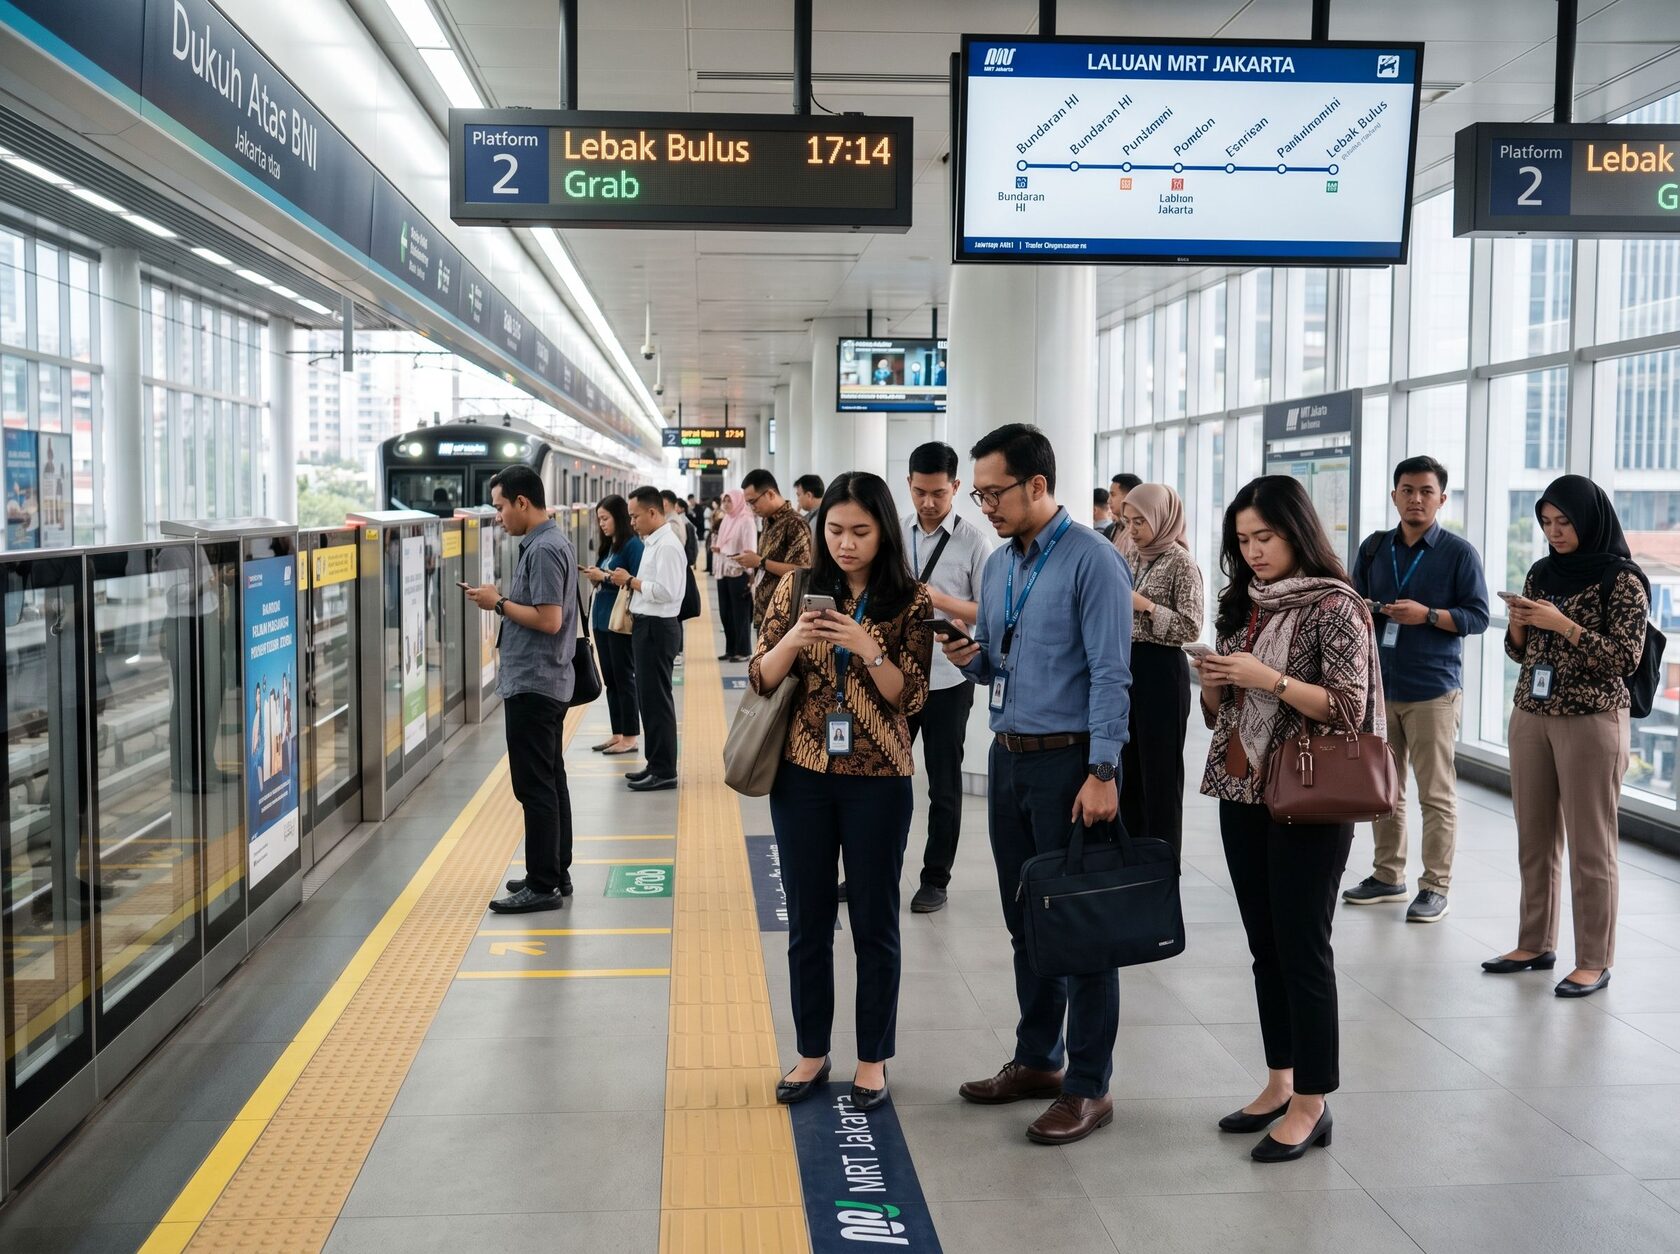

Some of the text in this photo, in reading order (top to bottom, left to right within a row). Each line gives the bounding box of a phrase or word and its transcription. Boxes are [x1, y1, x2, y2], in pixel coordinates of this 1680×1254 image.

[1088, 53, 1295, 73] LALUAN MRT JAKARTA
[173, 0, 317, 171] Dukuh Atas BNI
[1016, 93, 1080, 154] Bundaran HI
[1070, 94, 1133, 155] Bundaran HI
[1326, 128, 1359, 158] Lebak
[1357, 100, 1388, 129] Bulus
[235, 126, 266, 170] Jakarta
[472, 131, 539, 147] Platform
[564, 131, 891, 165] Lebak Bulus 17:14
[1500, 145, 1563, 159] Platform
[1587, 144, 1675, 172] Lebak
[492, 153, 520, 194] 2
[564, 170, 640, 199] Grab
[1517, 166, 1543, 206] 2
[998, 192, 1045, 202] Bundaran
[1016, 204, 1026, 212] HI
[1158, 205, 1194, 214] Jakarta
[667, 434, 676, 445] 2
[625, 869, 666, 895] Grab
[842, 1154, 886, 1192] MRT
